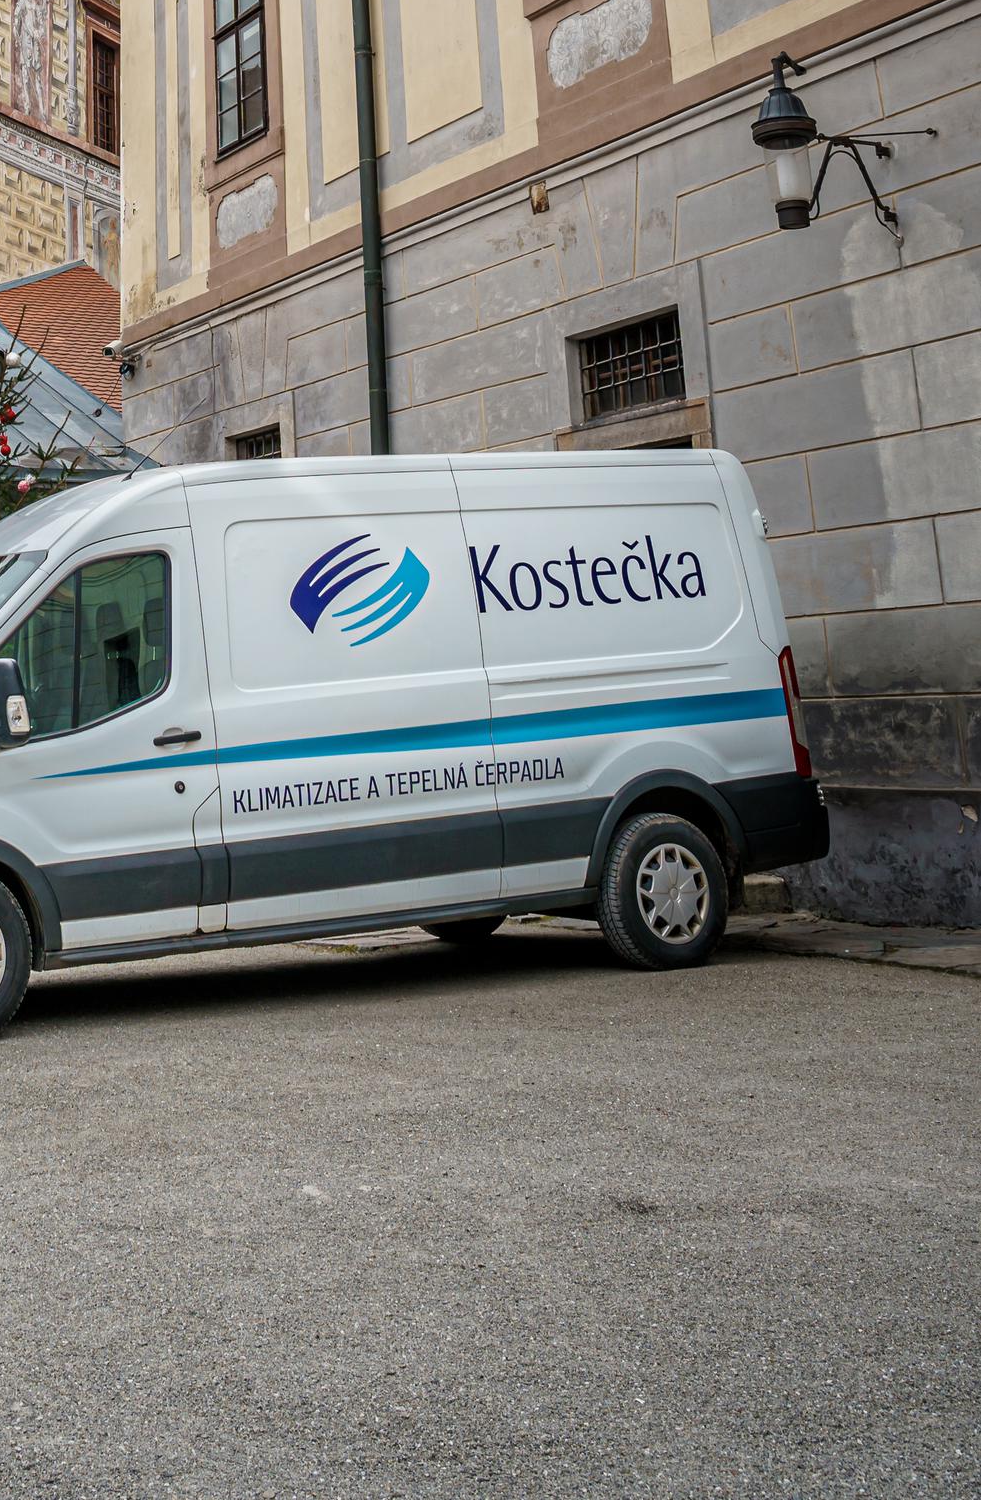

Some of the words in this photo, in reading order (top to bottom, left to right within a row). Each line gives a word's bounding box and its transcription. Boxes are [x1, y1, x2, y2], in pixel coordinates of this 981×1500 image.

[468, 534, 707, 614] Kostečka
[232, 777, 361, 814] KLIMATIZACE
[367, 775, 381, 800] A
[384, 762, 469, 797] TEPELNÁ
[474, 756, 565, 787] ČERPADLA
